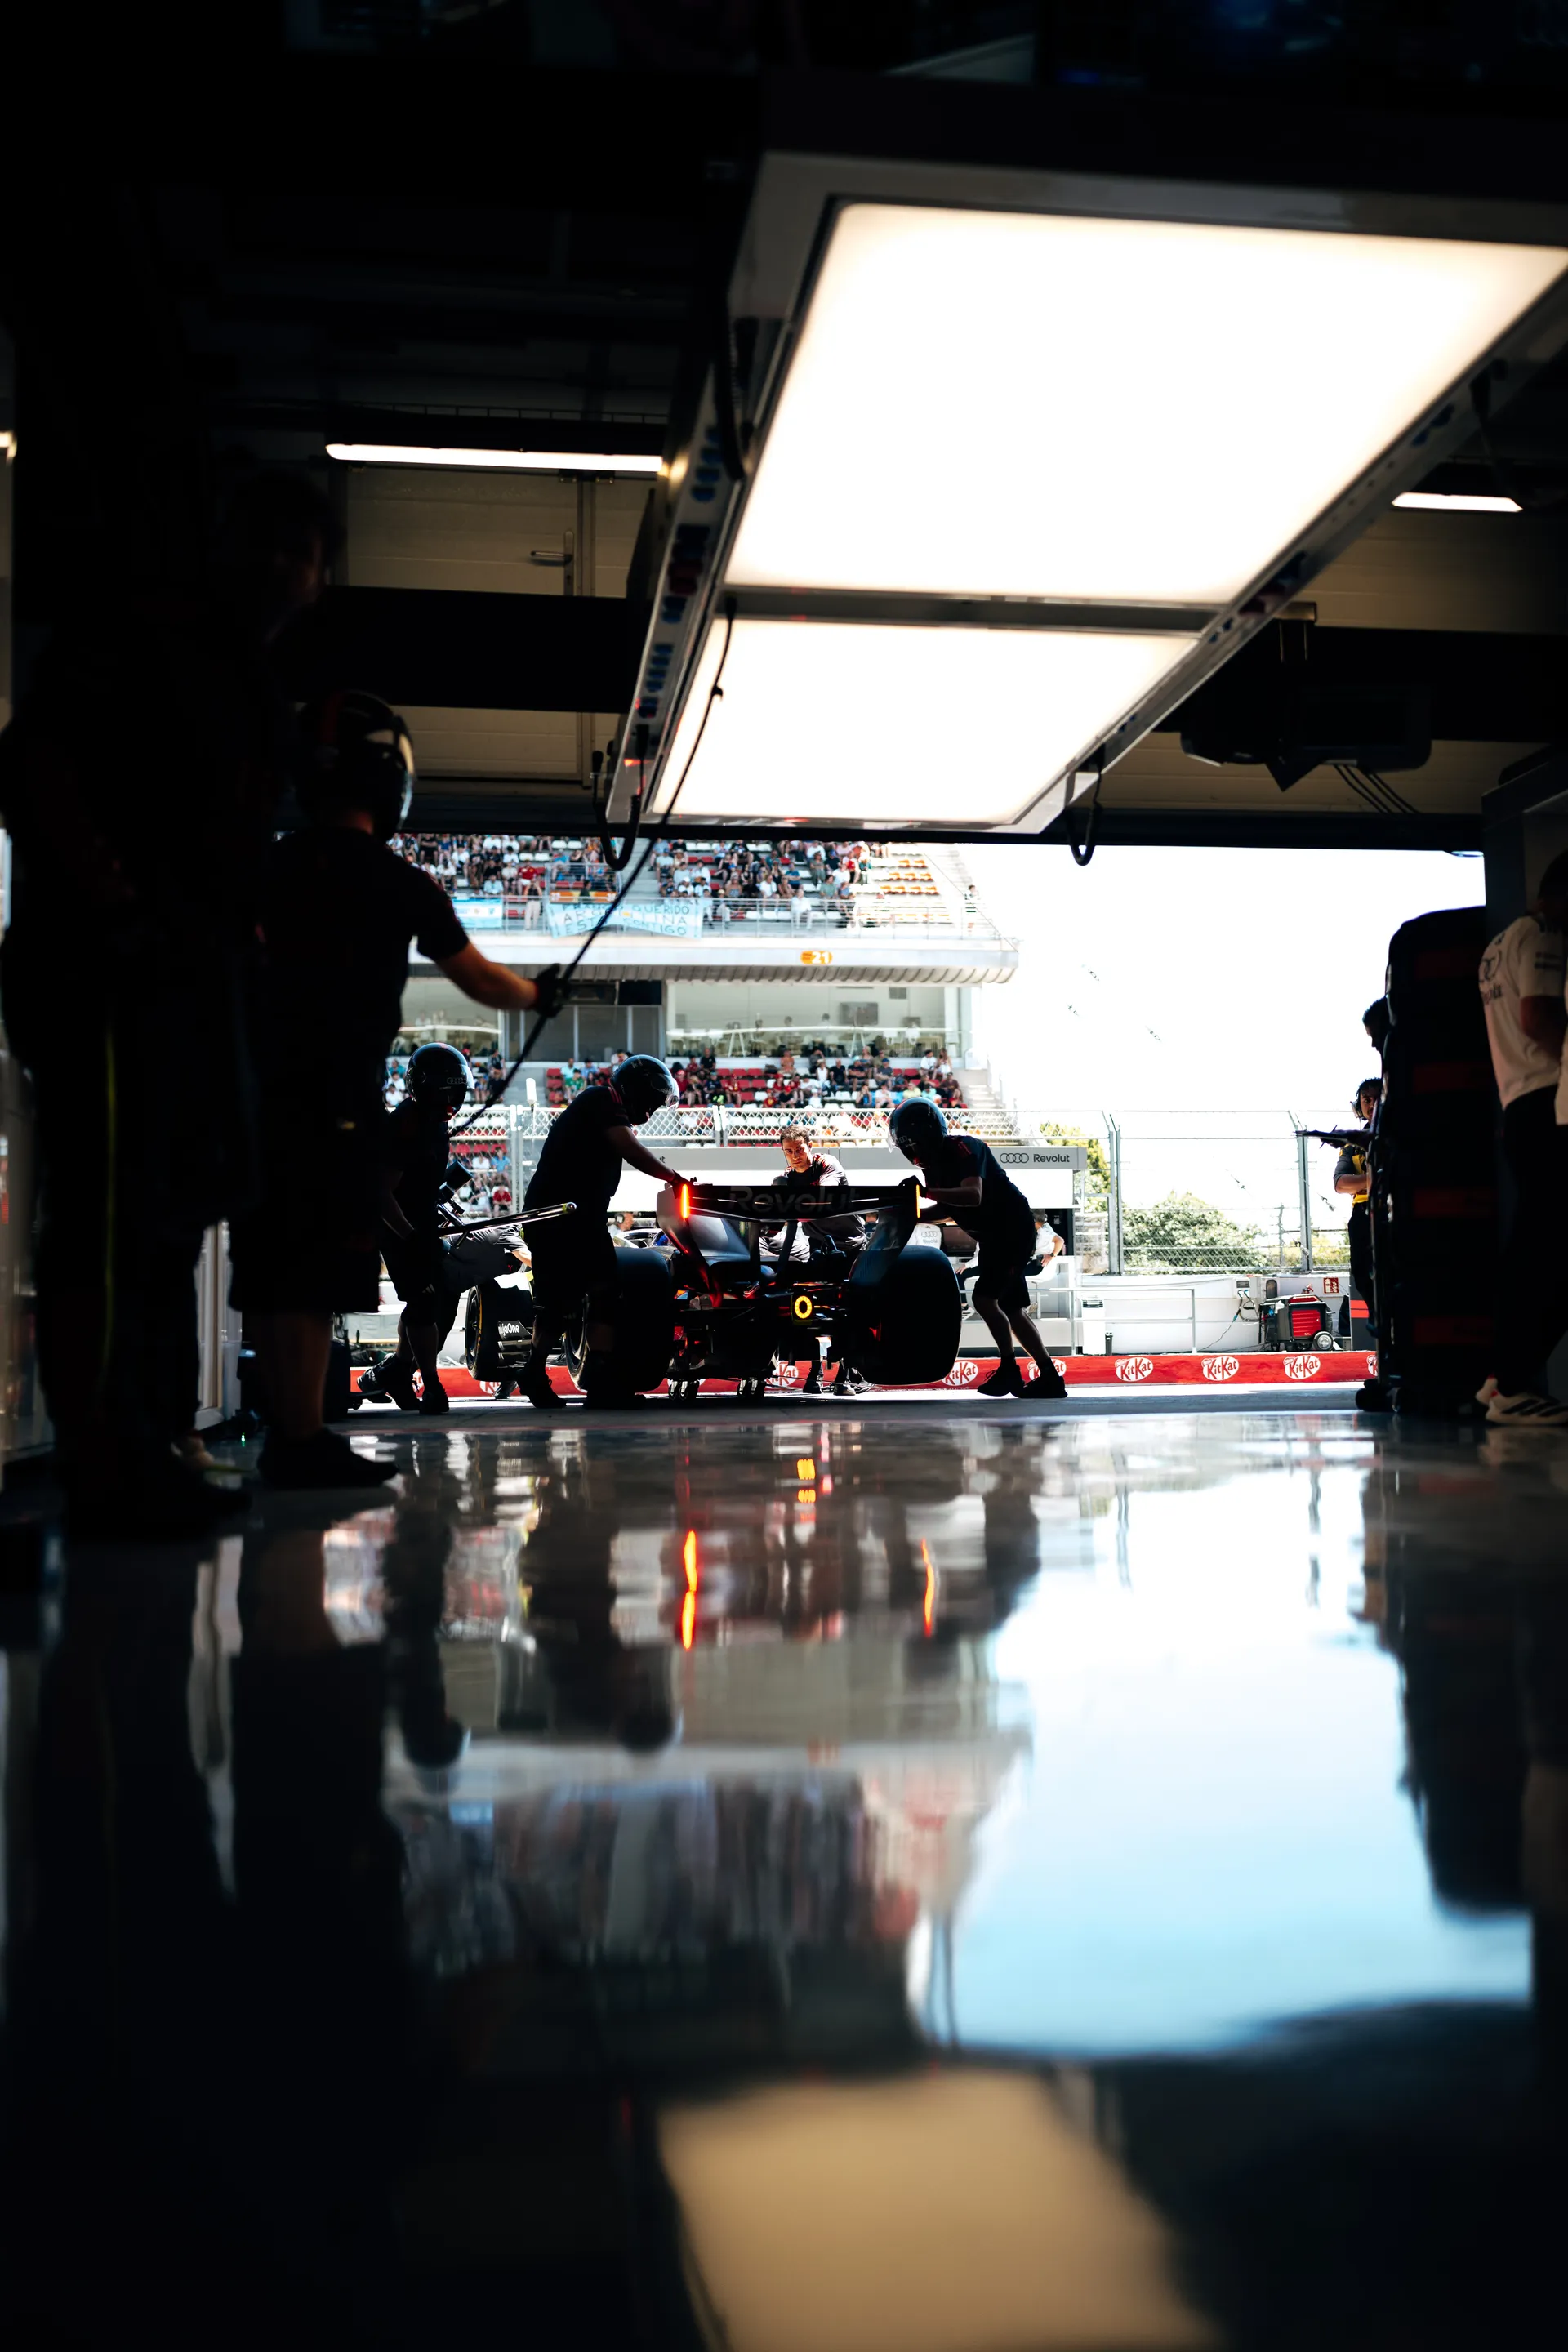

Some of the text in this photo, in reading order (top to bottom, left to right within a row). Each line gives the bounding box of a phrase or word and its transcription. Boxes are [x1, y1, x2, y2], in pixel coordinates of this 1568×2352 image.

[812, 951, 830, 964] 21
[1033, 1153, 1070, 1162] Revolut
[728, 1185, 862, 1214] Revolut
[1120, 1357, 1152, 1380] KitKat
[1207, 1356, 1237, 1380] KitKat
[1289, 1356, 1319, 1378] KitKat
